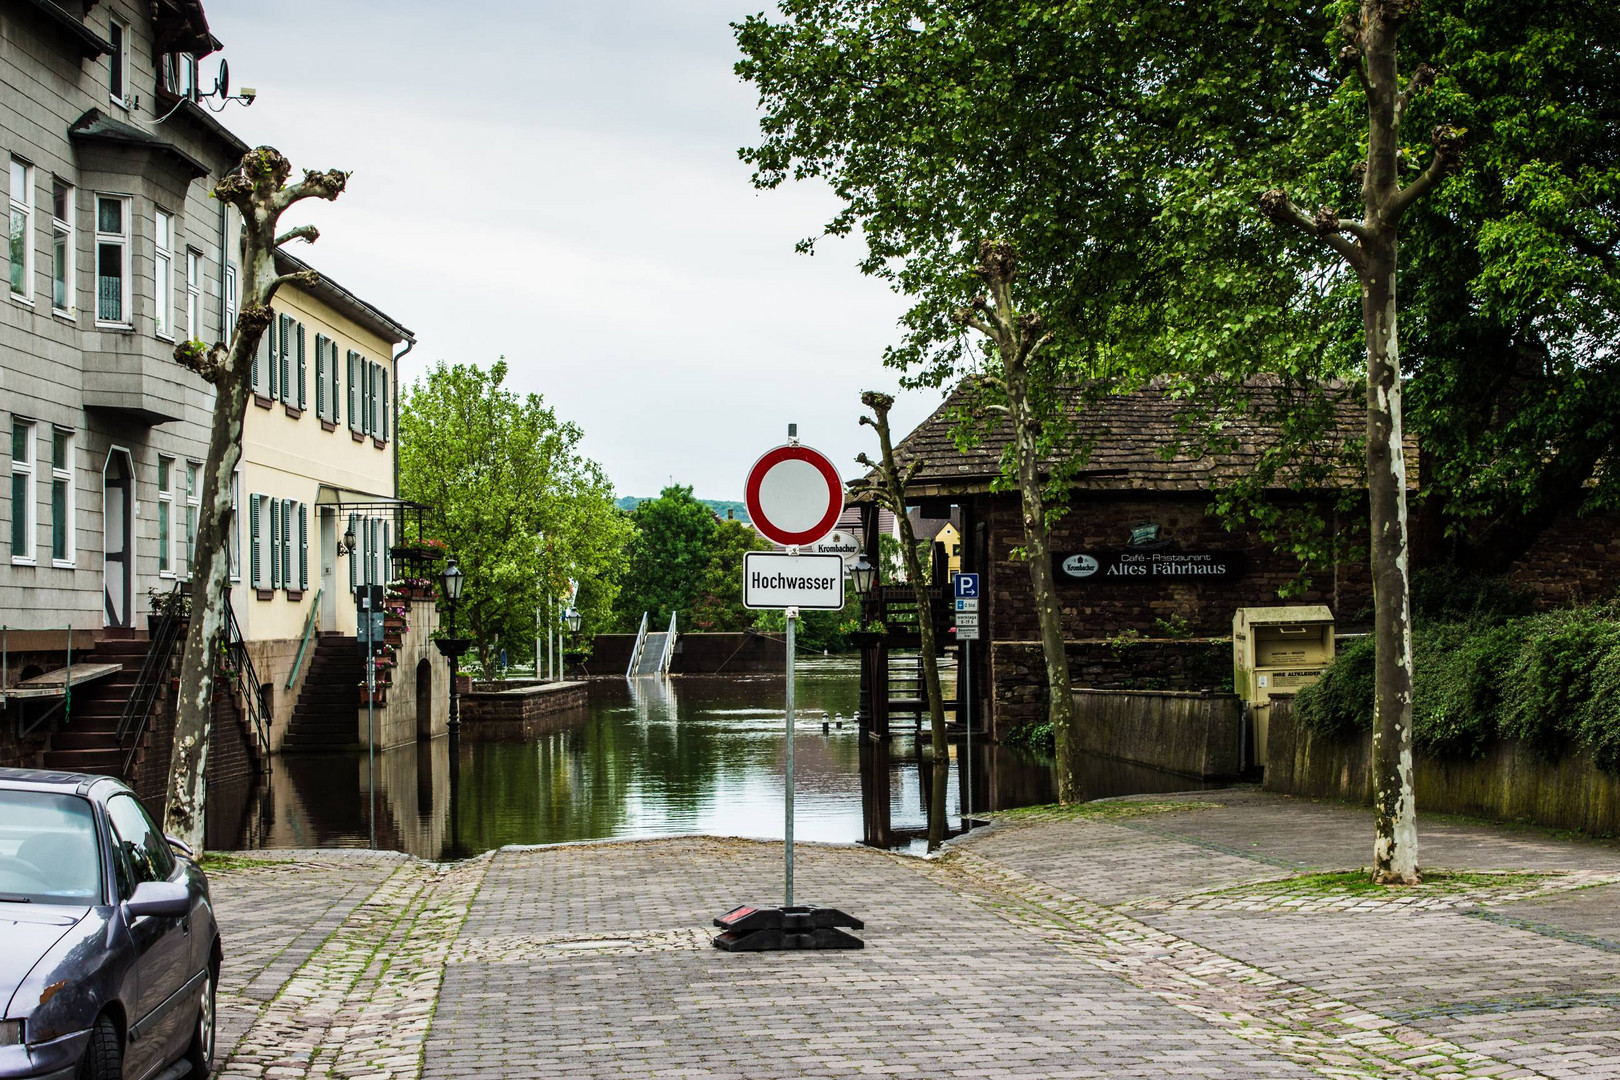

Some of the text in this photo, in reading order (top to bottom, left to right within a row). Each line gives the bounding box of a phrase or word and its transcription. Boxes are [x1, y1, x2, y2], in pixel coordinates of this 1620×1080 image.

[818, 544, 857, 553] Krombacher
[1120, 554, 1145, 562] Café
[1106, 562, 1226, 575] Altes Fährhaus
[752, 571, 836, 590] Hochwasser
[960, 577, 973, 595] P
